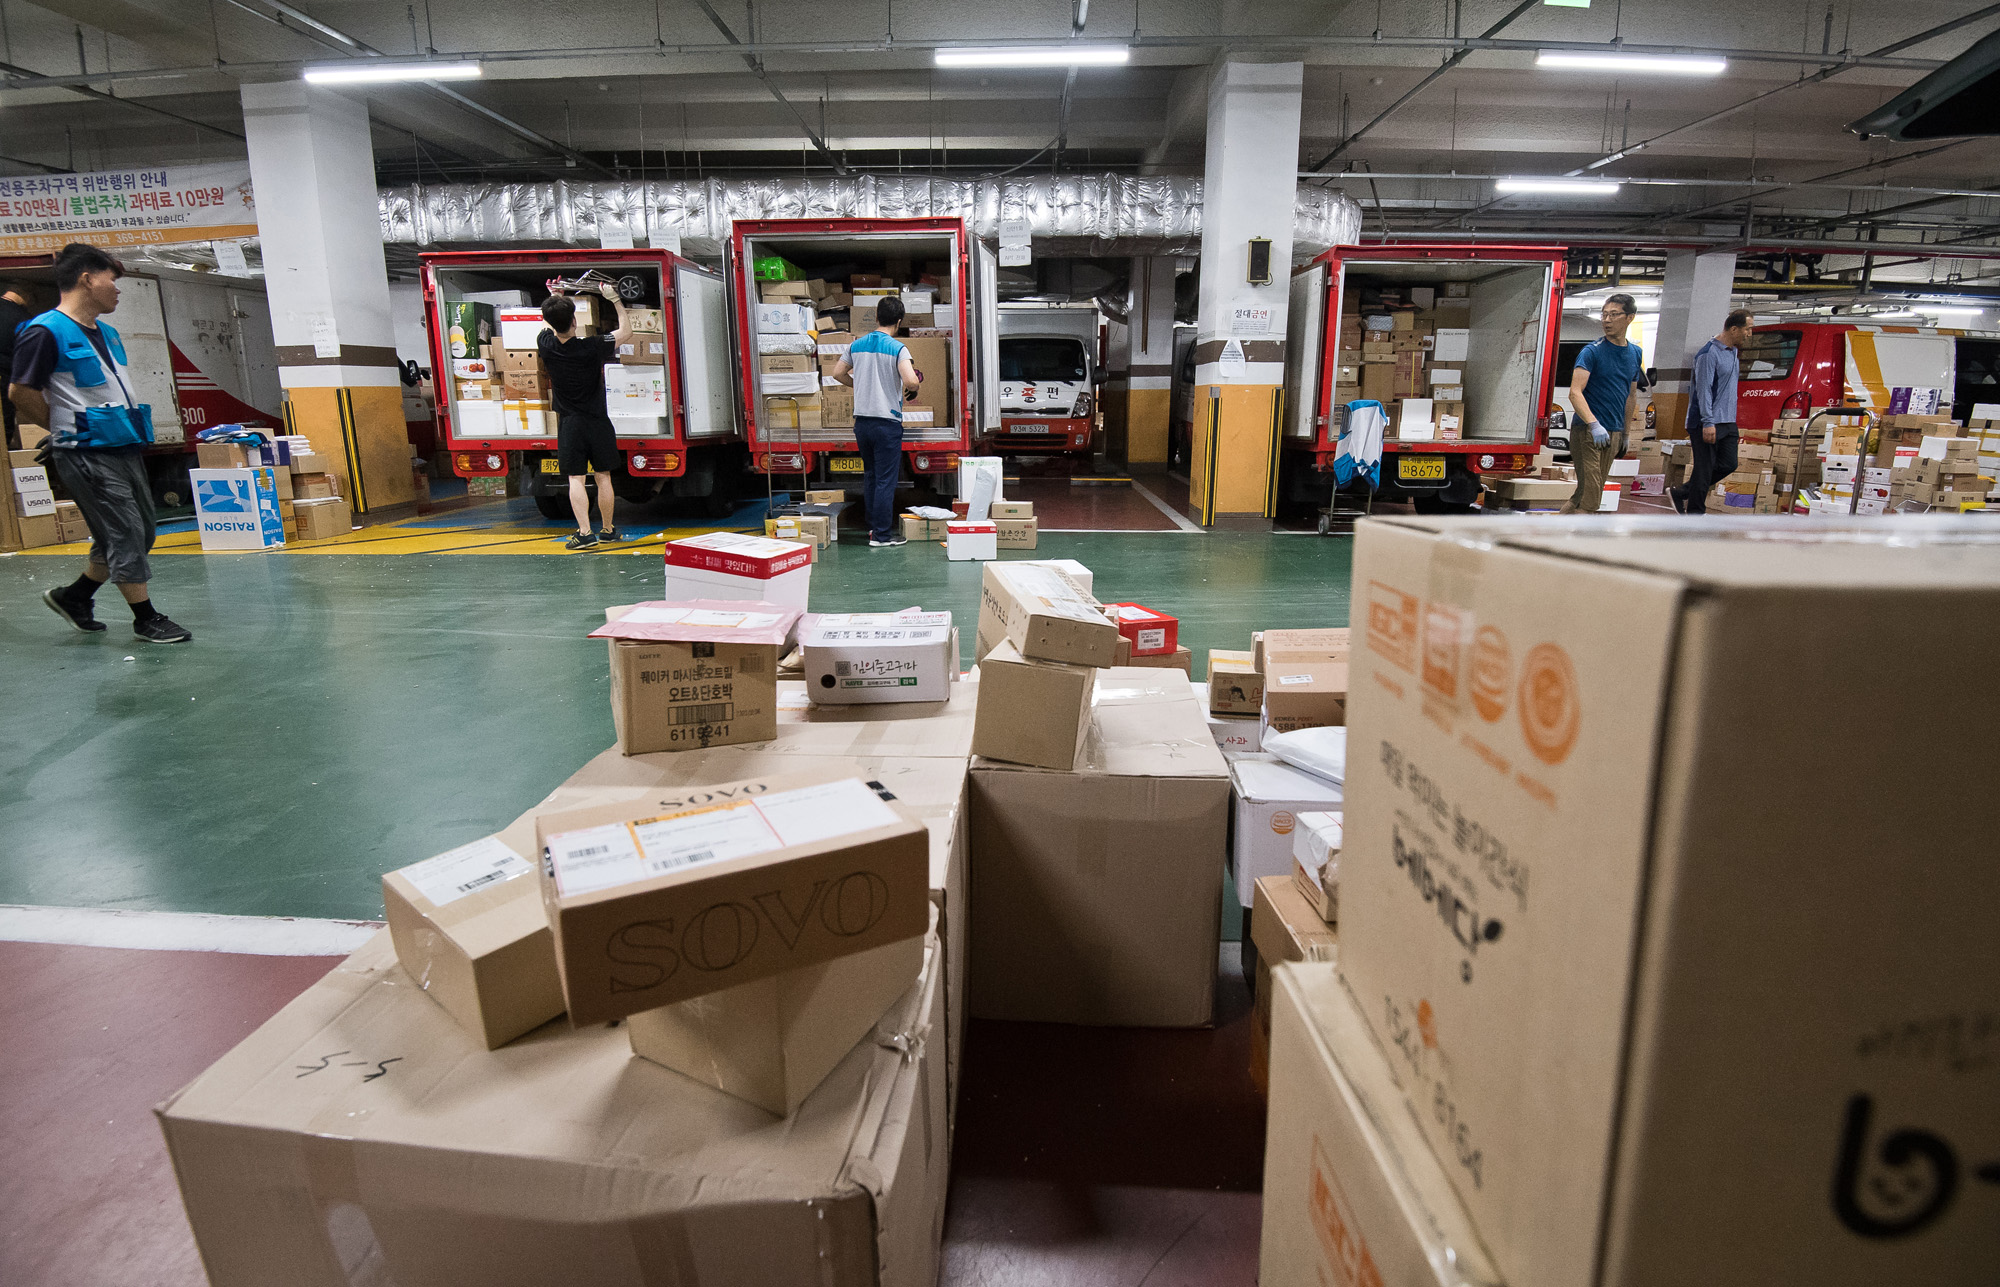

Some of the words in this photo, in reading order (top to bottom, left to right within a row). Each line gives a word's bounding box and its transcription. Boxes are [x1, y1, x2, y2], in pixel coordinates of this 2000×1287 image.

[0, 176, 79, 198] 전용주차구역
[82, 173, 136, 192] 위반행위
[140, 171, 168, 189] 안내
[14, 198, 61, 218] 50만원
[70, 193, 127, 216] 불법주차
[129, 190, 175, 212] 과태료
[176, 187, 225, 208] 10만원
[88, 218, 120, 229] 과태료가
[121, 216, 144, 226] 부과될
[146, 217, 154, 225] 수
[115, 231, 165, 244] 369-4151
[1234, 309, 1268, 320] 절대금연
[1001, 386, 1013, 397] 우
[1047, 386, 1059, 399] 편
[1029, 425, 1046, 433] 5322
[19, 474, 45, 483] USANA
[26, 498, 52, 507] USANA
[205, 522, 255, 532] RAISON
[263, 527, 282, 536] RAISON
[853, 659, 917, 675] 김의준고구마
[640, 669, 670, 684] 퀘이커
[704, 666, 733, 680] 오트밀
[669, 683, 733, 702] 오트&단호박
[1225, 735, 1248, 745] 사과
[658, 781, 769, 810] SOVO
[606, 870, 891, 996] SOVO
